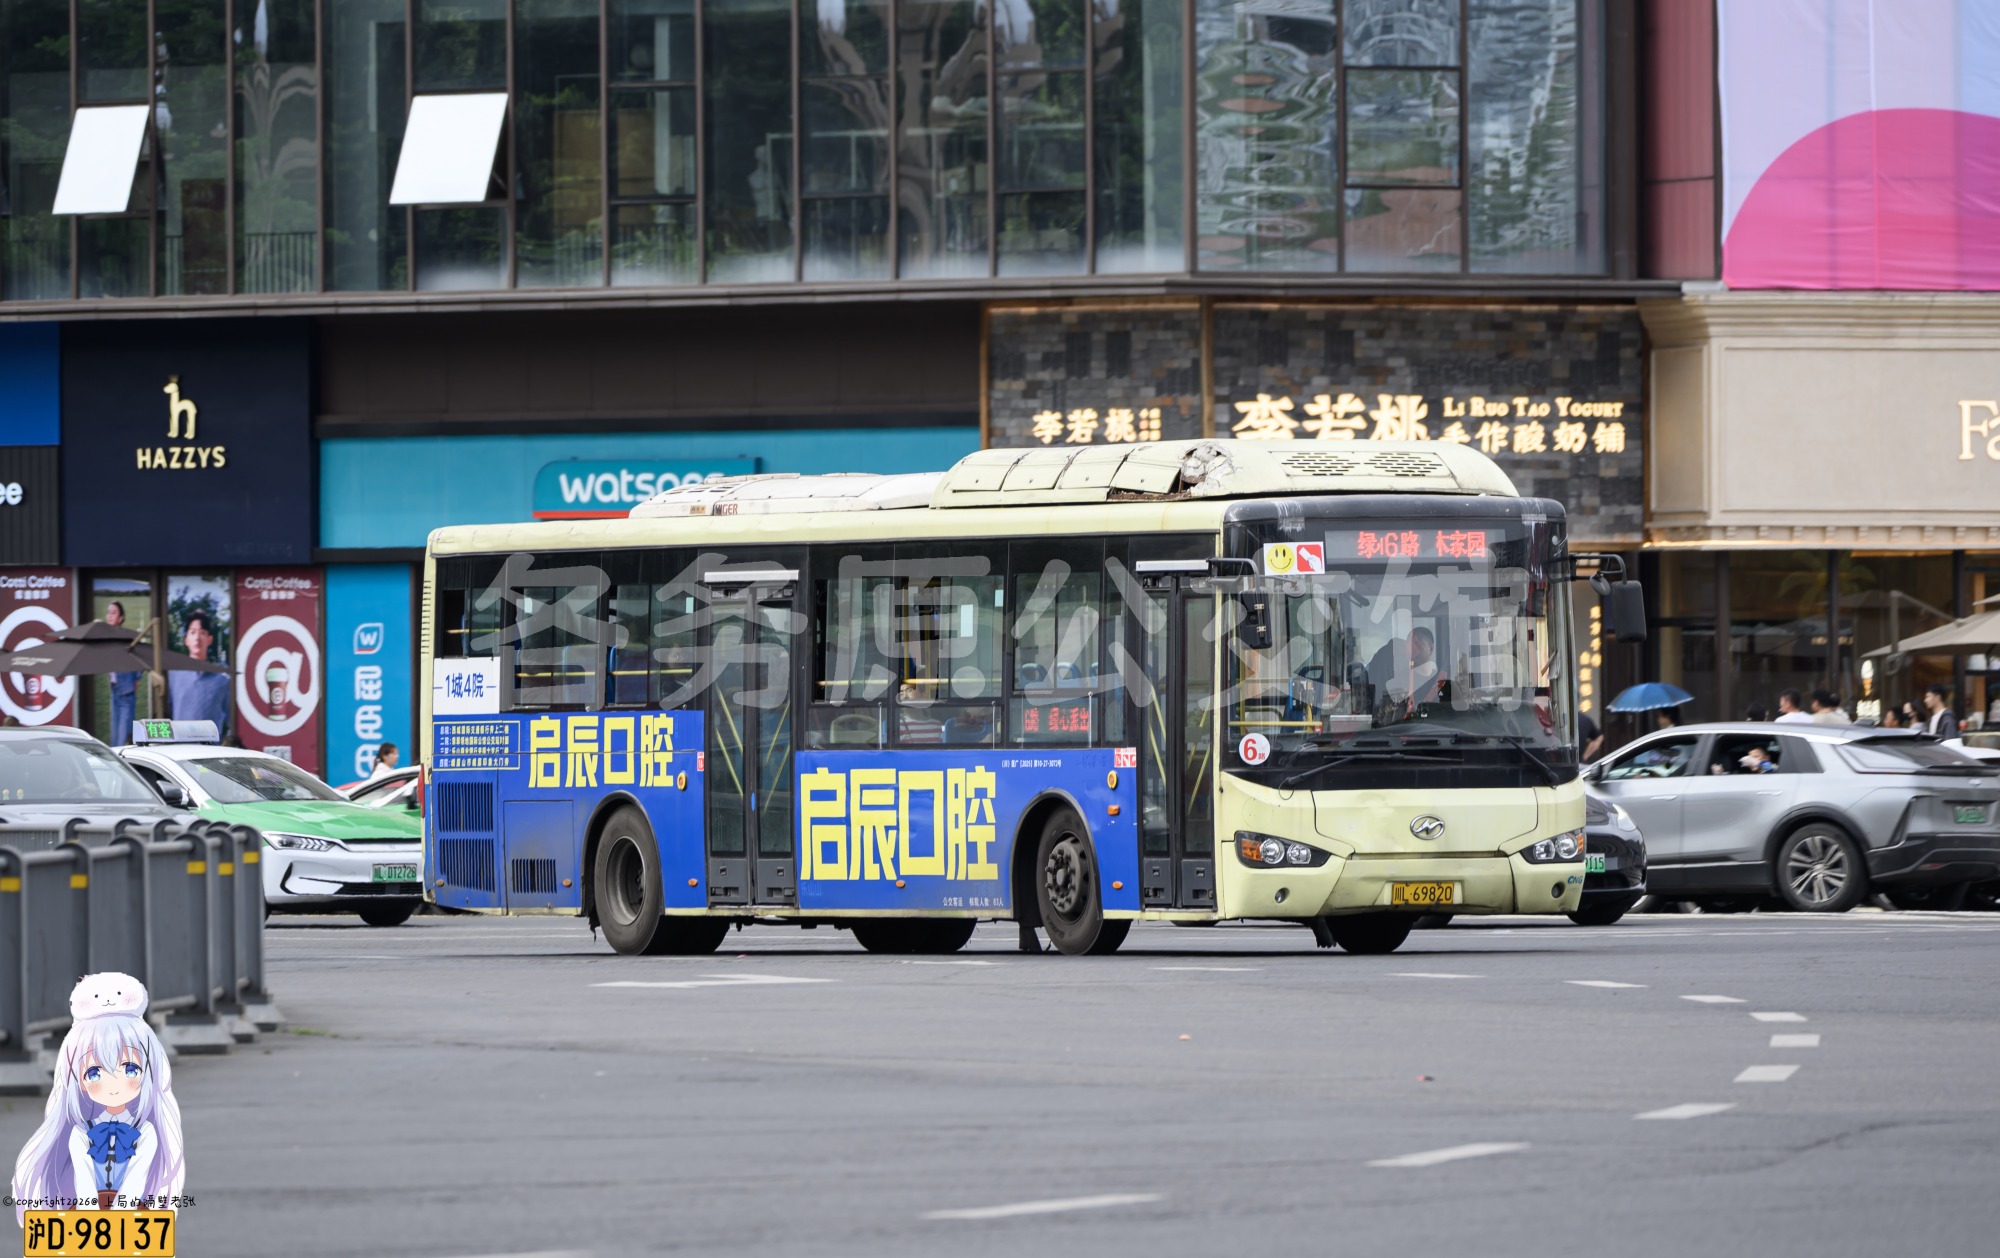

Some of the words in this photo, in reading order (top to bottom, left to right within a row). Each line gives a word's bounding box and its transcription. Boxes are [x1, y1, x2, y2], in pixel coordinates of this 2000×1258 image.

[1031, 407, 1137, 445] 李若桃
[1231, 392, 1430, 441] 李若桃
[1437, 420, 1626, 454] 手作酸奶铺
[135, 446, 227, 470] HAZZYS
[146, 721, 171, 738] 有客
[528, 713, 674, 788] 启辰口腔
[800, 765, 998, 880] 启辰口腔
